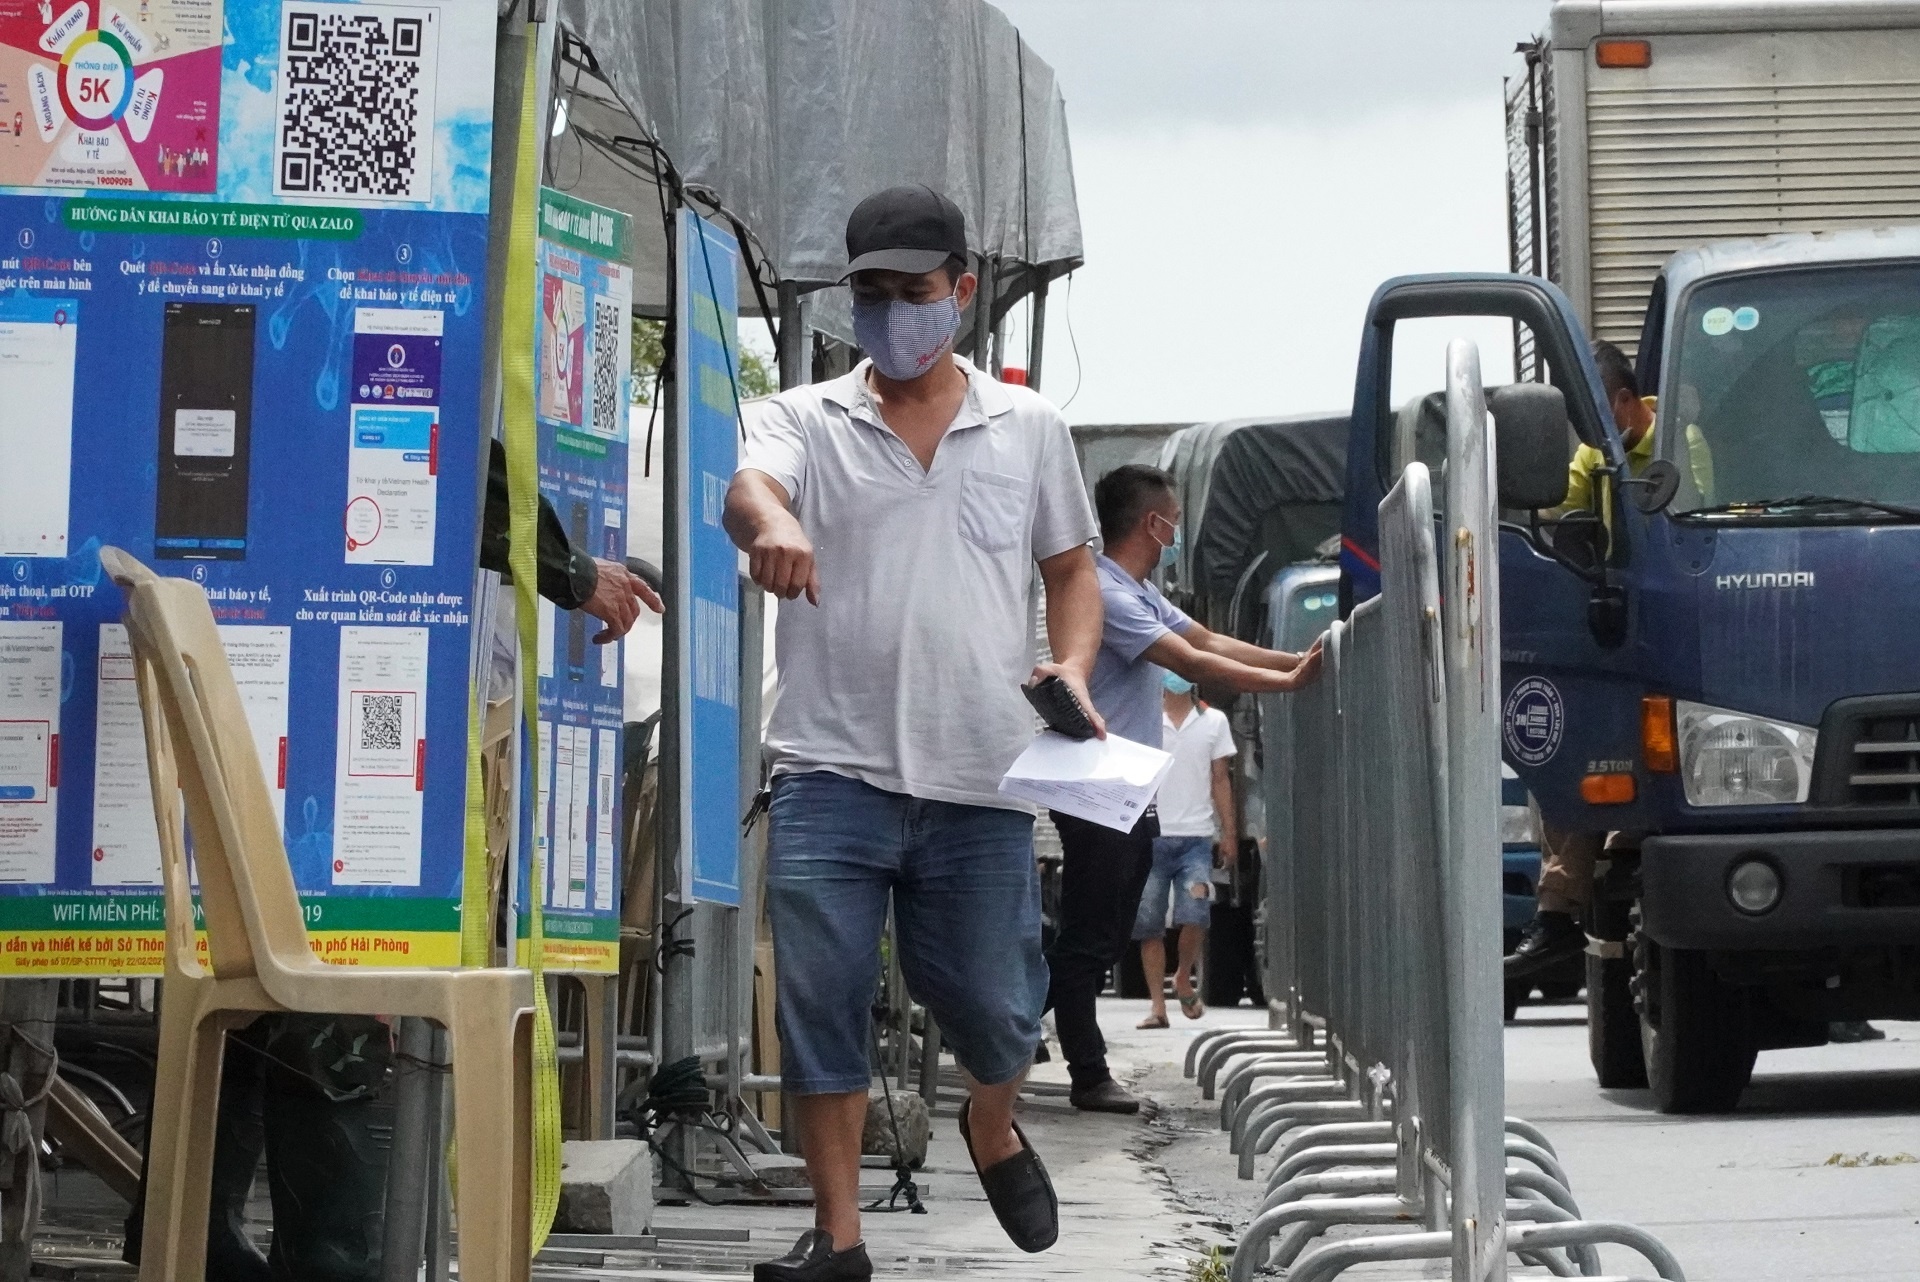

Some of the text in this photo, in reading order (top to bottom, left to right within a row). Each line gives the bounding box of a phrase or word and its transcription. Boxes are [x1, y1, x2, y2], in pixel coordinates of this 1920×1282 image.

[64, 9, 84, 32] TRANG
[75, 61, 101, 71] THÔNG
[79, 77, 111, 104] 5K
[77, 132, 95, 146] KHAI
[86, 150, 91, 159] Y
[72, 206, 354, 230] HƯỚNG DẪN KHAI BÁO Y TẾ ĐIỆN TỬ QUA ZALO
[2, 257, 20, 269] nút
[73, 258, 92, 272] bên
[120, 260, 146, 275] Quét
[198, 263, 211, 276] và
[213, 261, 226, 277] ấn
[228, 264, 249, 277] Xác
[251, 265, 277, 281] nhận
[279, 263, 305, 282] đồng
[20, 276, 41, 289] trên
[43, 277, 66, 290] màn
[68, 277, 92, 291] hình
[327, 267, 355, 283] Chọn
[139, 277, 285, 300] ý để chuyển sang tờ khai y tế
[340, 284, 457, 305] để khai báo y tế điện tử
[1716, 571, 1815, 590] HYUNDAI
[51, 585, 67, 598] mã
[69, 585, 95, 598] OTP
[229, 587, 248, 601] báo
[249, 591, 256, 604] y
[304, 586, 463, 608] Xuất trình QR-Code nhận được
[296, 606, 469, 626] cho cơ quan kiểm soát để xác nhận
[53, 904, 85, 921] WIFI
[89, 898, 127, 922] MIỄN
[131, 900, 160, 921] PHÍ:
[6, 936, 165, 953] dẫn và thiết kế bởi Sở Thôn
[326, 936, 348, 954] phố
[351, 937, 370, 952] Hải
[374, 937, 410, 955] Phòng
